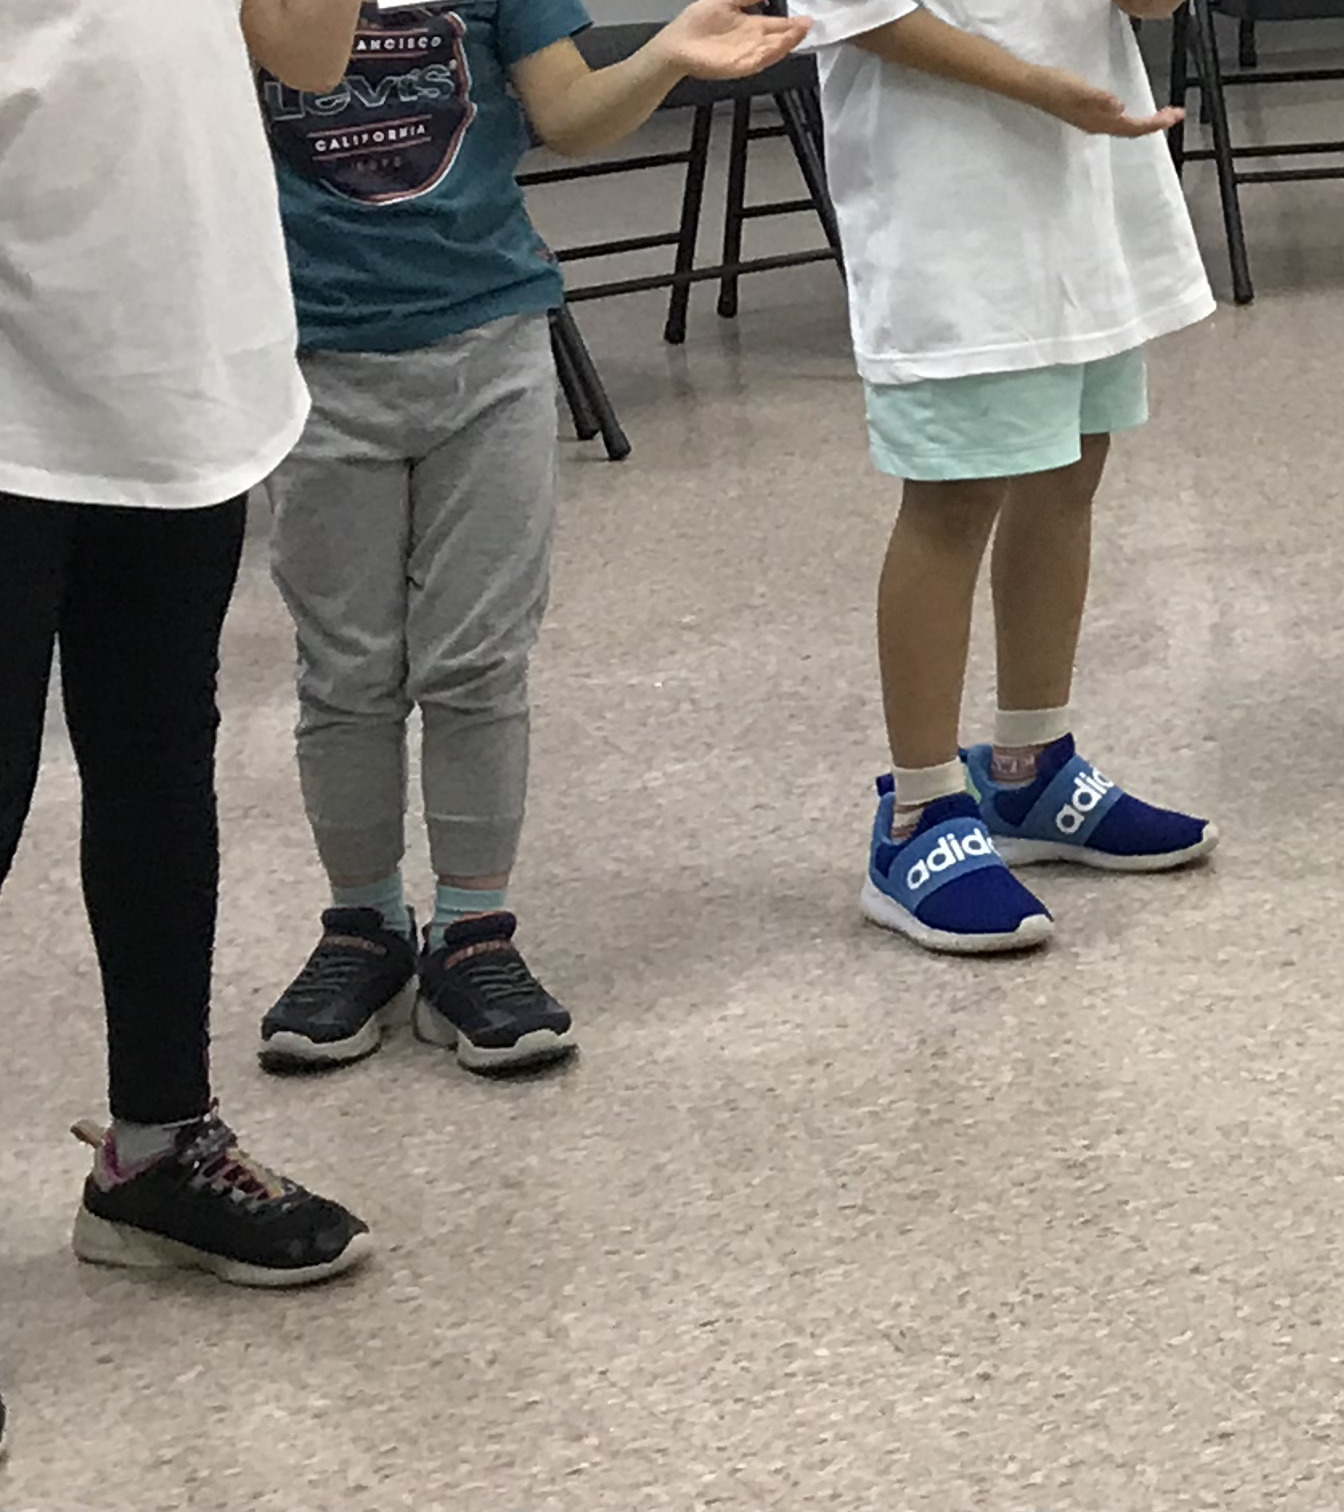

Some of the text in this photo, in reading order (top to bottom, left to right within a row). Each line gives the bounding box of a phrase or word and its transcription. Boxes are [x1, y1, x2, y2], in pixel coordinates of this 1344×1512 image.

[355, 36, 442, 51] ANCISCO
[315, 123, 426, 152] CALIFORNIA
[1056, 767, 1113, 835] adid
[907, 828, 1000, 890] adid
